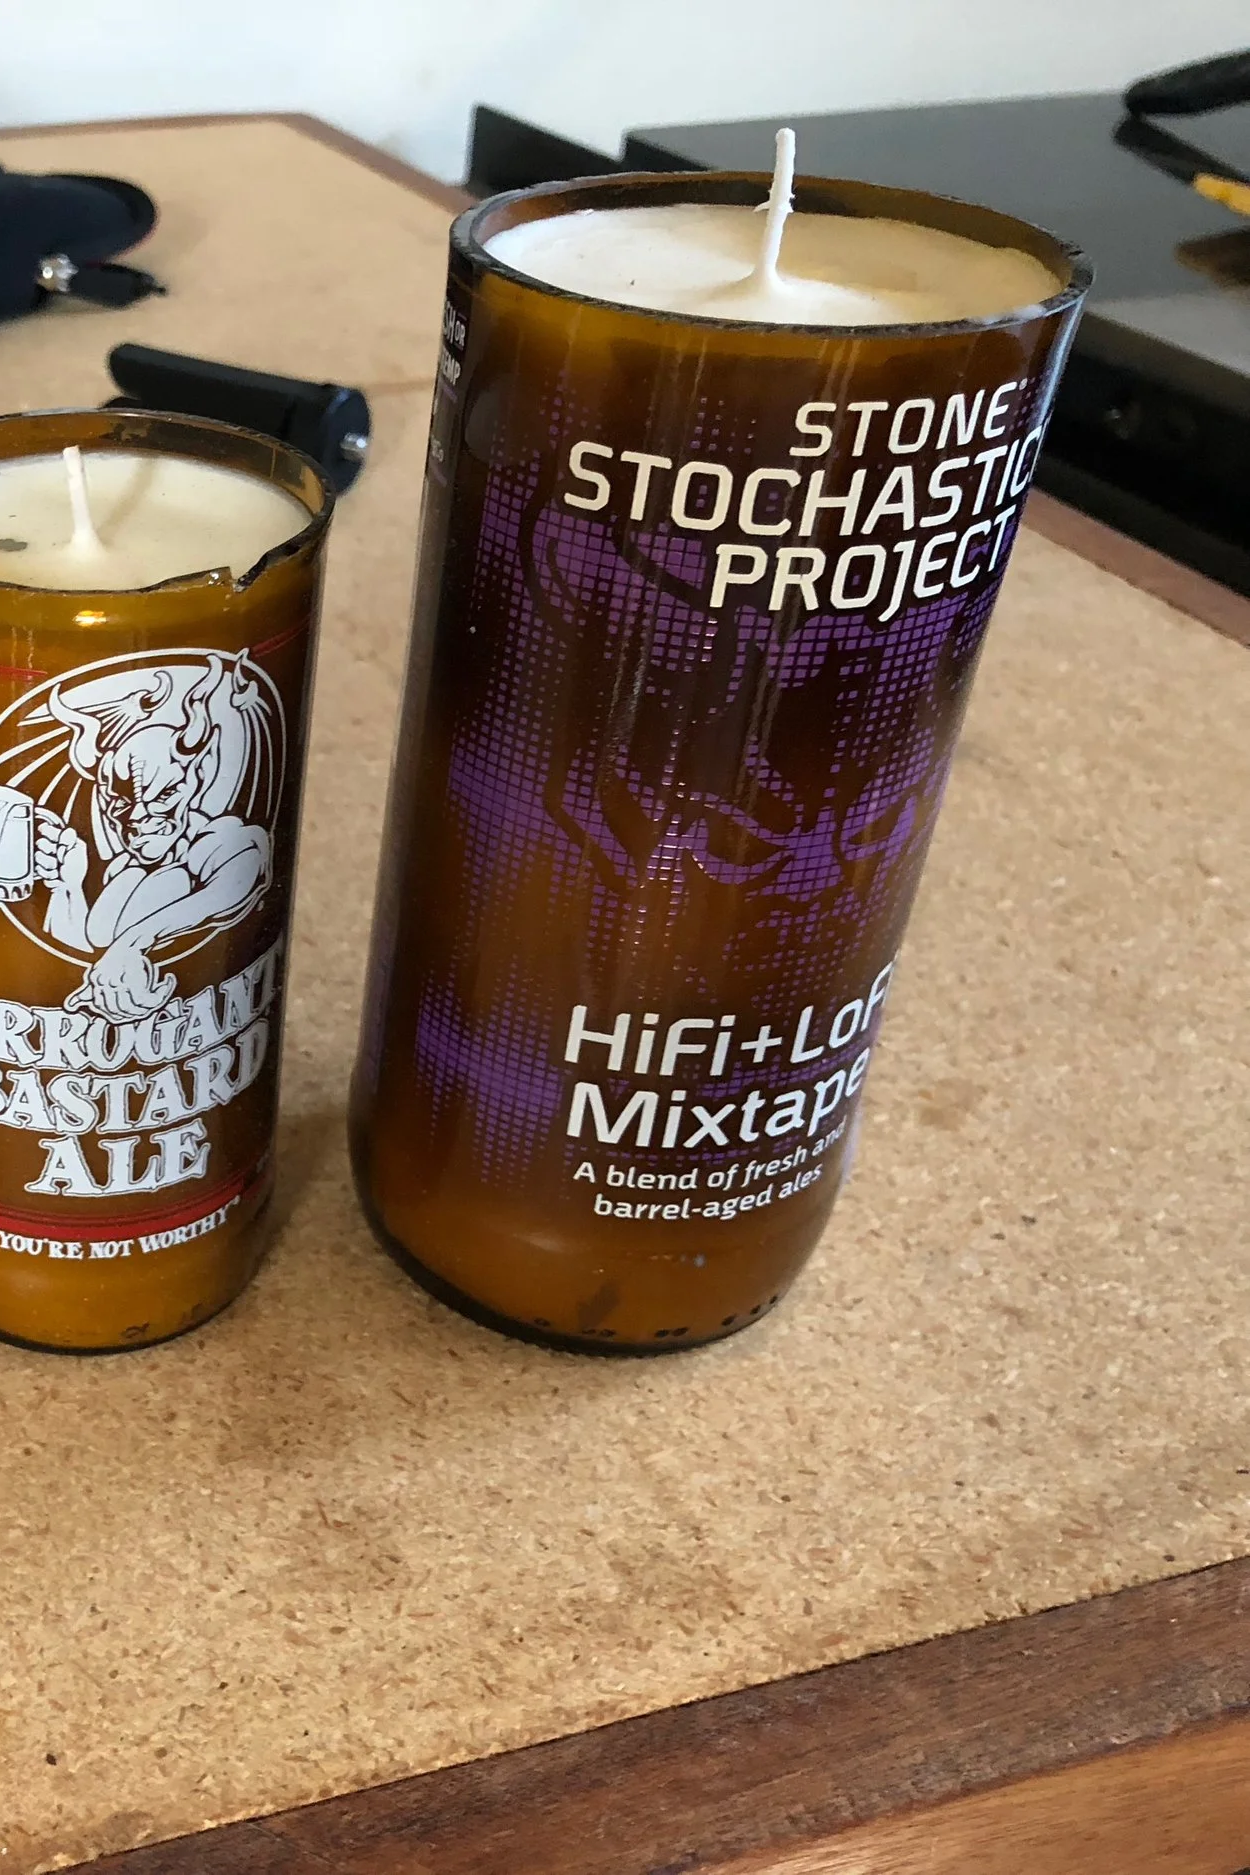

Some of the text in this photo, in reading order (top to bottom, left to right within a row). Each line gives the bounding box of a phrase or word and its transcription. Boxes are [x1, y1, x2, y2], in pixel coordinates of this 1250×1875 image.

[789, 380, 1018, 458] STONE
[563, 422, 1044, 537] STOCHASTIC
[708, 504, 1017, 623] PROJECT
[565, 1047, 870, 1149] Mixtape
[24, 1118, 211, 1197] ALE
[573, 1115, 848, 1191] A blend of fresh and
[593, 1162, 823, 1221] barrel-aged ales
[88, 1240, 135, 1259] NOT
